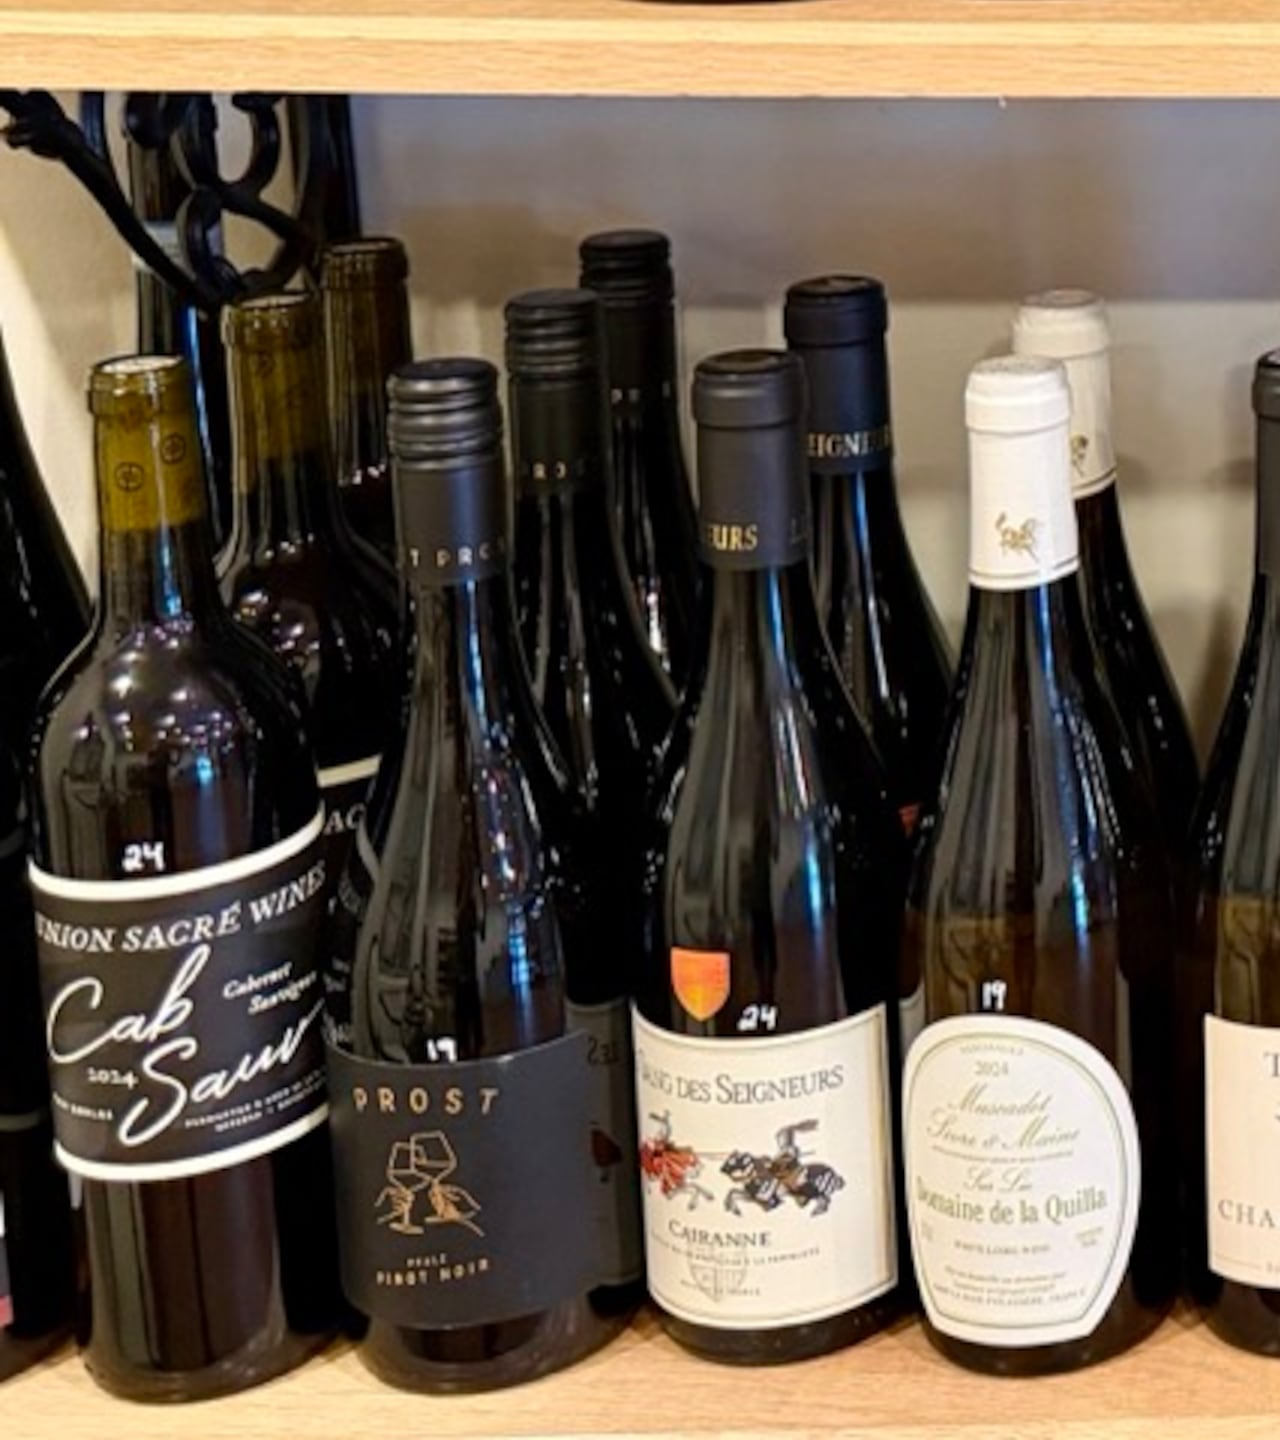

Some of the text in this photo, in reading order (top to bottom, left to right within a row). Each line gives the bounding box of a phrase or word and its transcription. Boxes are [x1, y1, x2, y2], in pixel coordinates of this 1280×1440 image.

[121, 842, 165, 872] 24
[122, 900, 241, 951] SACRÉ
[47, 944, 209, 1063] Cab
[737, 1004, 777, 1032] 24
[119, 998, 326, 1146] Sauv
[677, 1064, 845, 1105] DES SEIGNEURS
[352, 1087, 499, 1115] PROST
[990, 1200, 1014, 1224] de
[1020, 1199, 1039, 1223] la
[1046, 1186, 1108, 1225] Quilla
[669, 1219, 772, 1249] CAIRANNE
